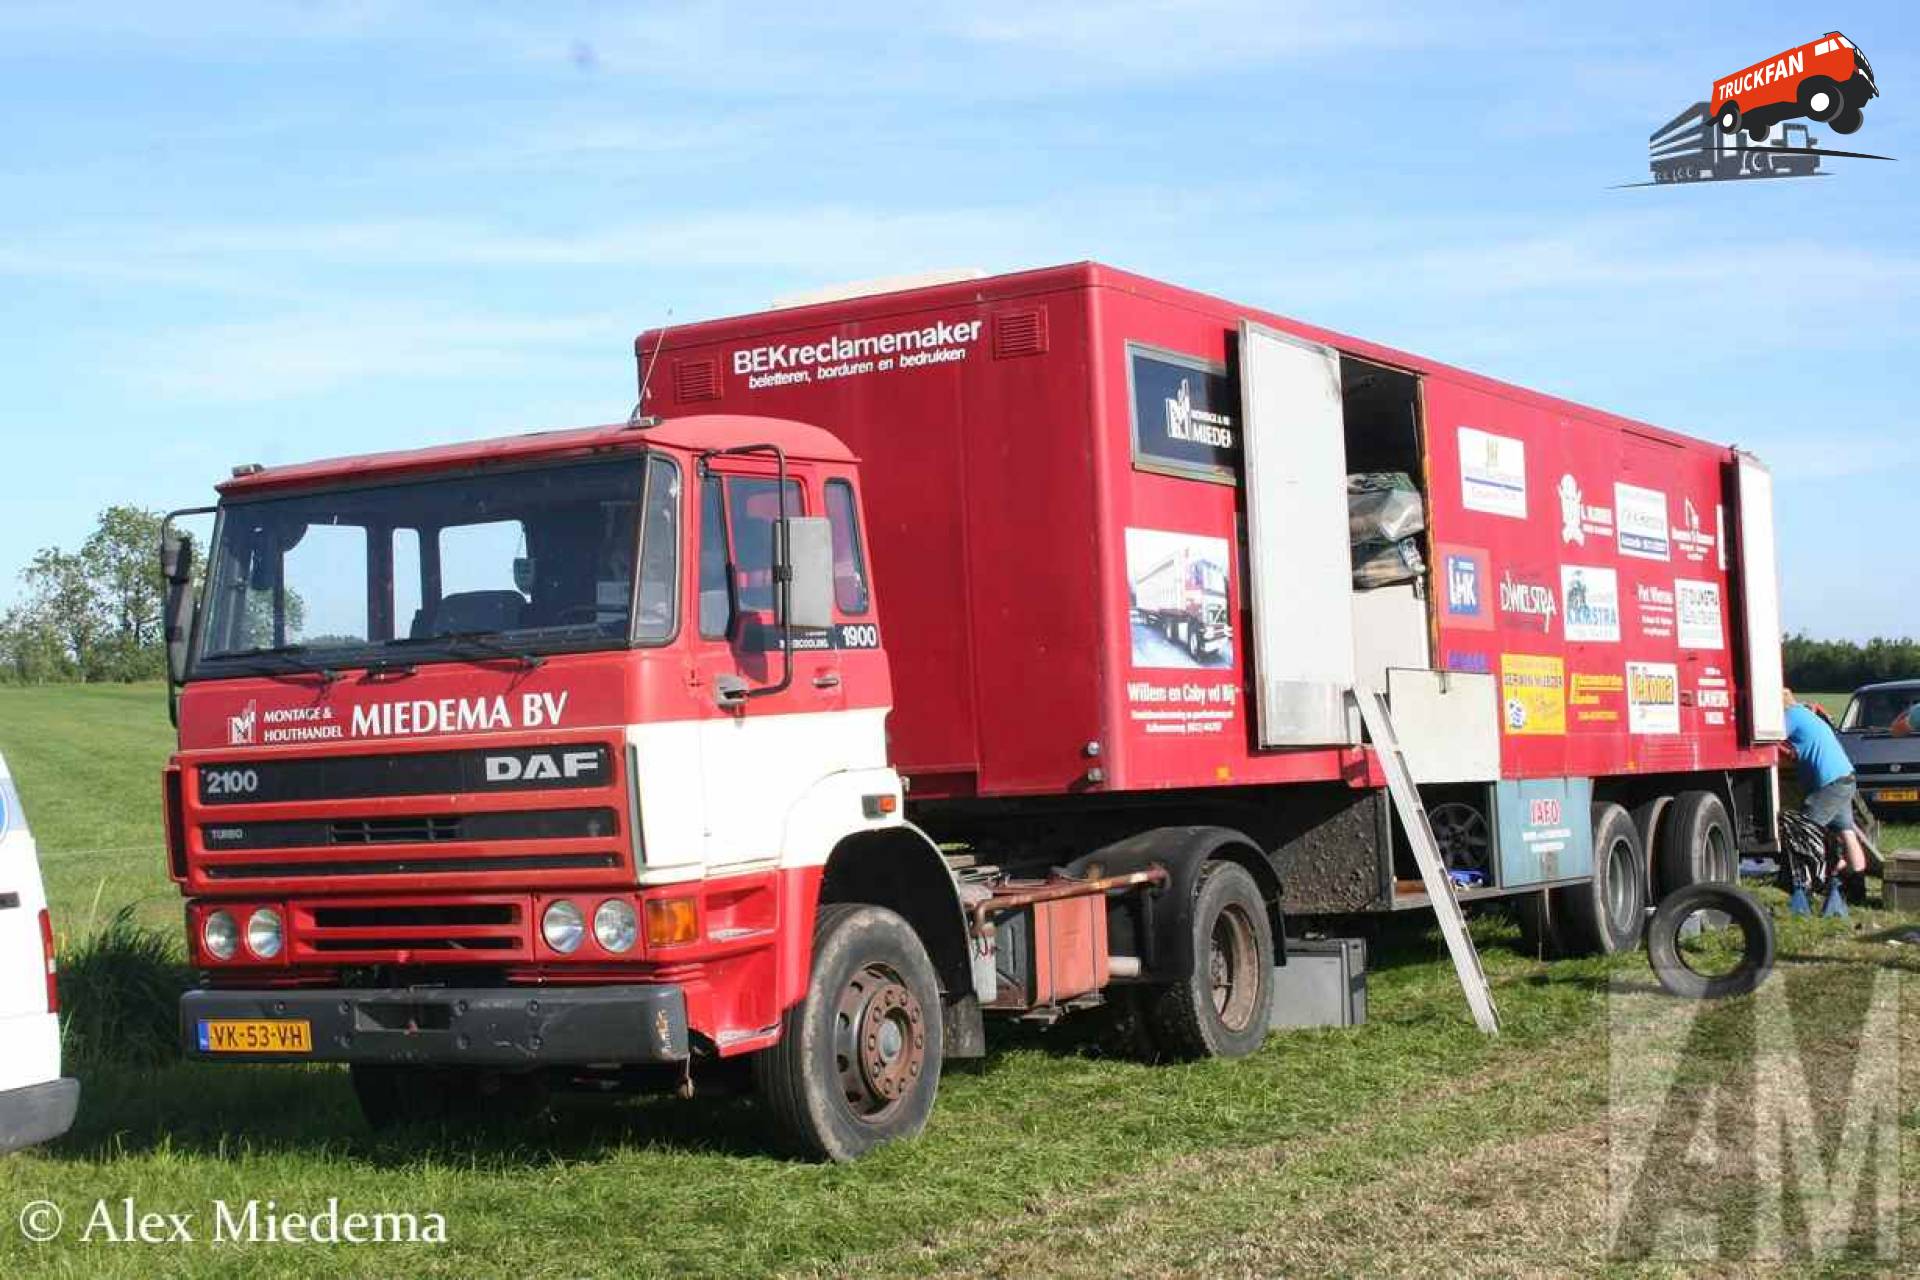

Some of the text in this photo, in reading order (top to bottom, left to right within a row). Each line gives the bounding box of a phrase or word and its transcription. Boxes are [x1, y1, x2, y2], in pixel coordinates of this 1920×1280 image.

[733, 320, 983, 375] BEKreclamemaker
[817, 360, 873, 380] borduren
[878, 357, 894, 371] en
[900, 346, 966, 368] bedrukken
[842, 625, 877, 648] 1900
[263, 706, 333, 724] MONTAGE &
[351, 690, 568, 738] MIEDEMA BV
[263, 725, 343, 743] HOUTHANDEL
[486, 751, 599, 782] DAF
[207, 769, 259, 794] 2100
[213, 1023, 304, 1049] VK-53-VH
